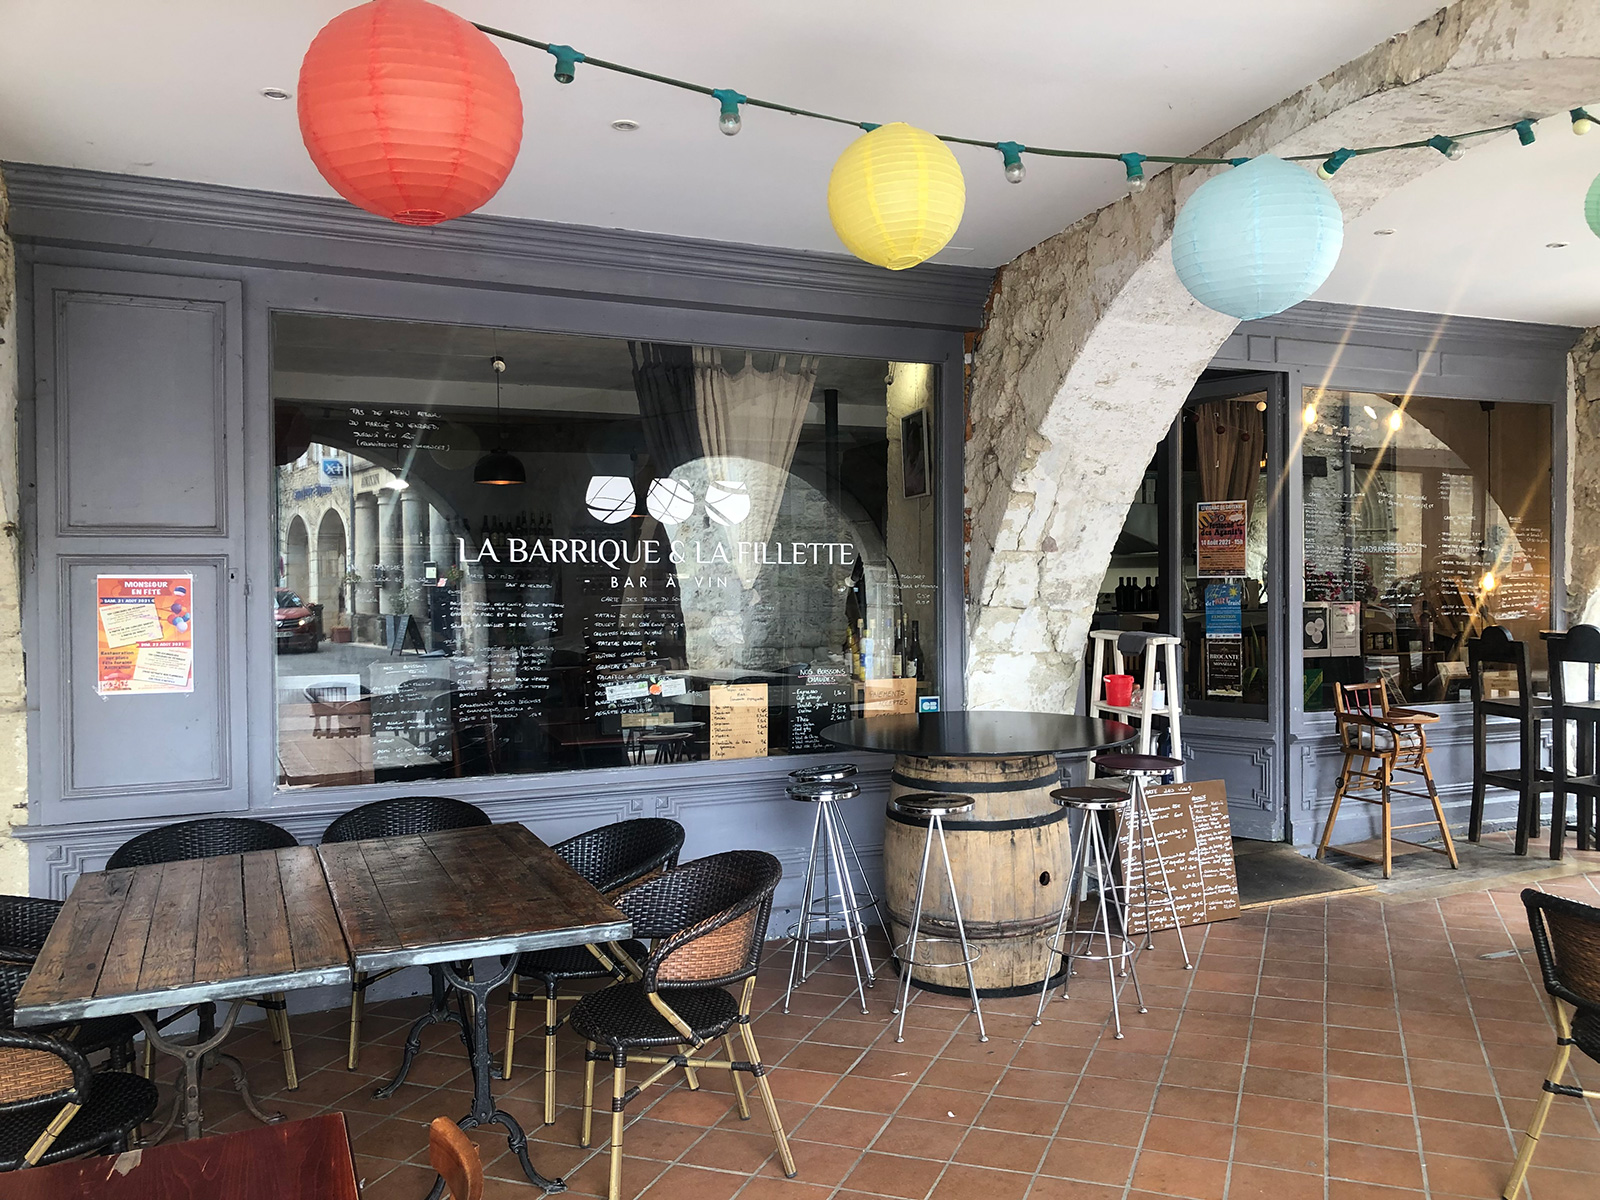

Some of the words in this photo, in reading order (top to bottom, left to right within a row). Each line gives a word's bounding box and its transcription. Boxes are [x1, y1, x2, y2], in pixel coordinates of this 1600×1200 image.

[457, 537, 501, 564] LA
[507, 537, 661, 570] BARRIQUE
[668, 539, 687, 564] &
[694, 540, 734, 564] LA
[737, 541, 855, 566] FILLETTE
[610, 576, 648, 588] BAR
[666, 573, 680, 588] À
[693, 576, 728, 588] VIN
[816, 668, 847, 676] BOISSONS
[922, 701, 938, 710] CB
